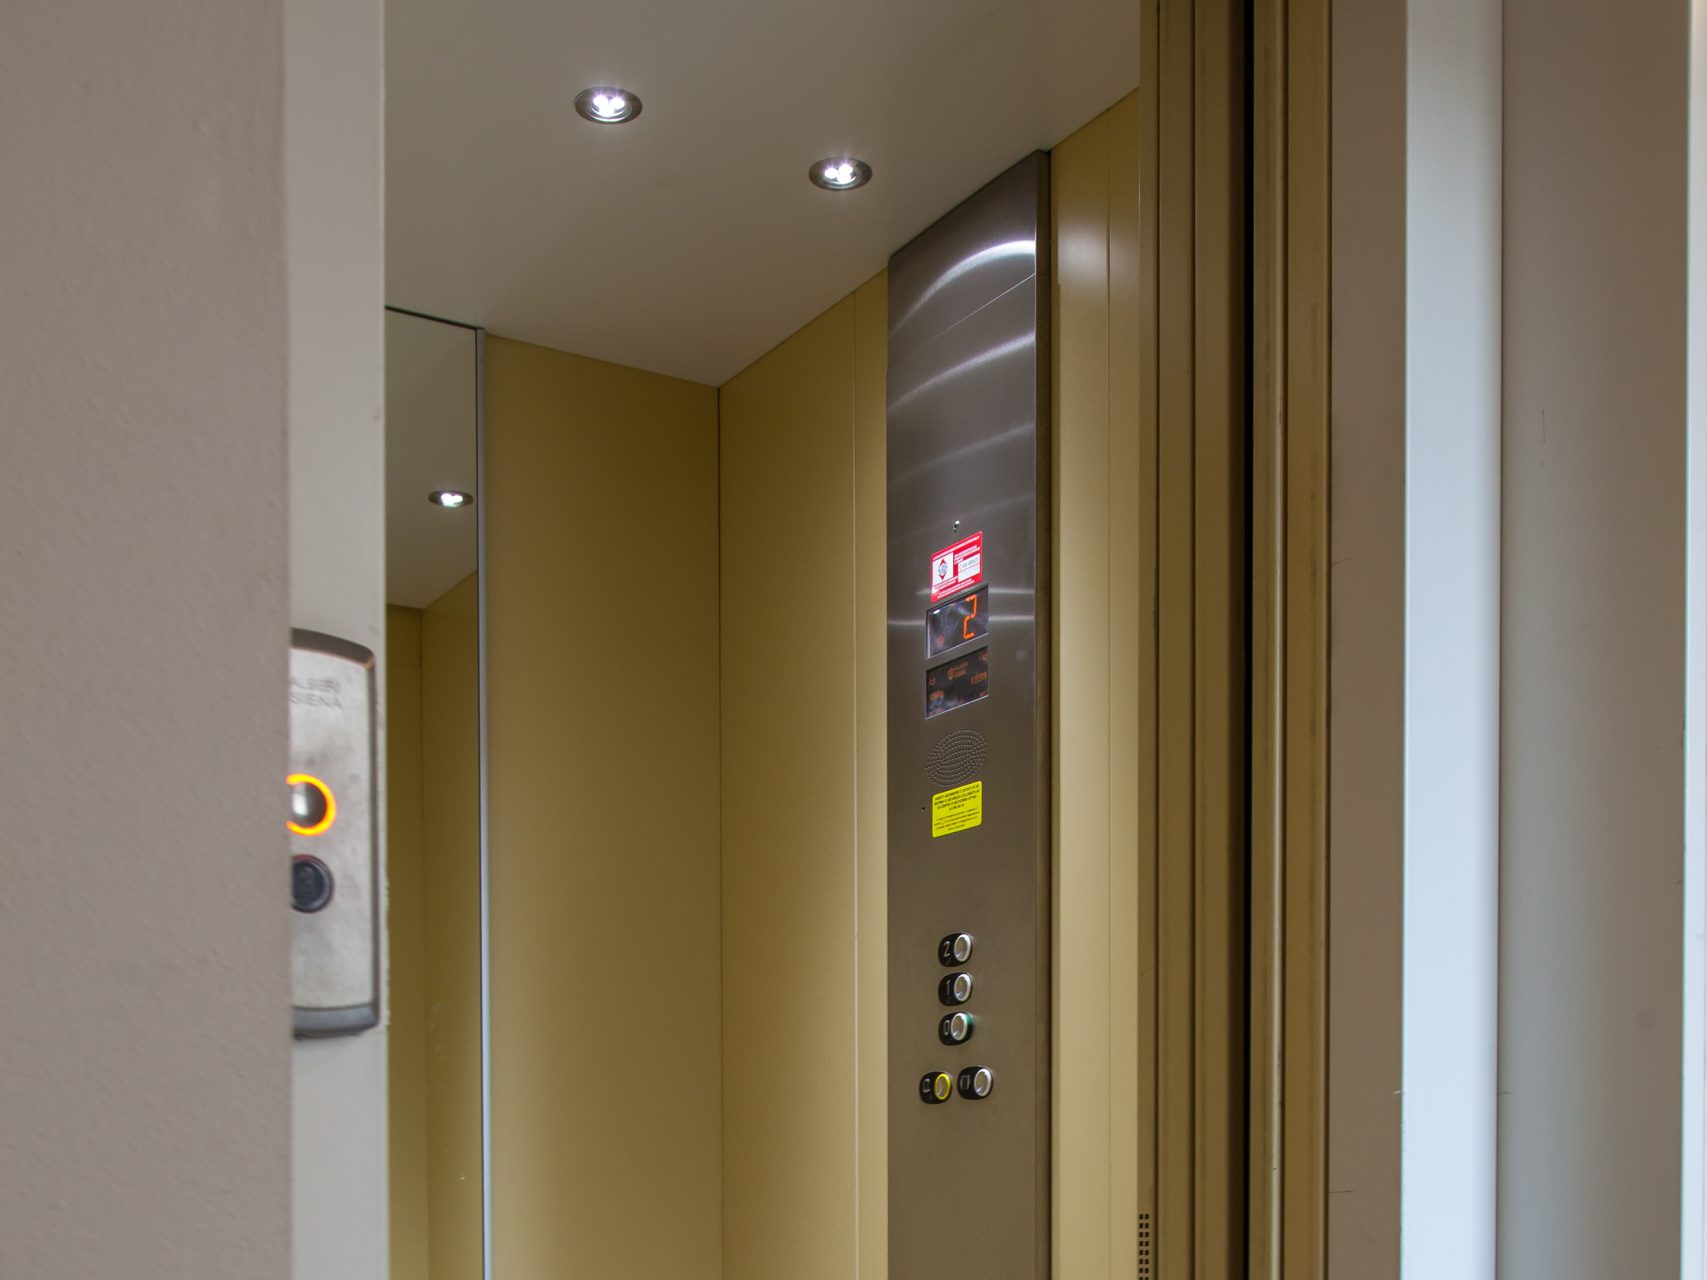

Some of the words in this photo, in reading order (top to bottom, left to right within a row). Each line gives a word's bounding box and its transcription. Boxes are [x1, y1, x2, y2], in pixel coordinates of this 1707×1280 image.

[963, 594, 977, 640] 2
[943, 941, 951, 957] 2
[943, 1020, 951, 1035] 0
